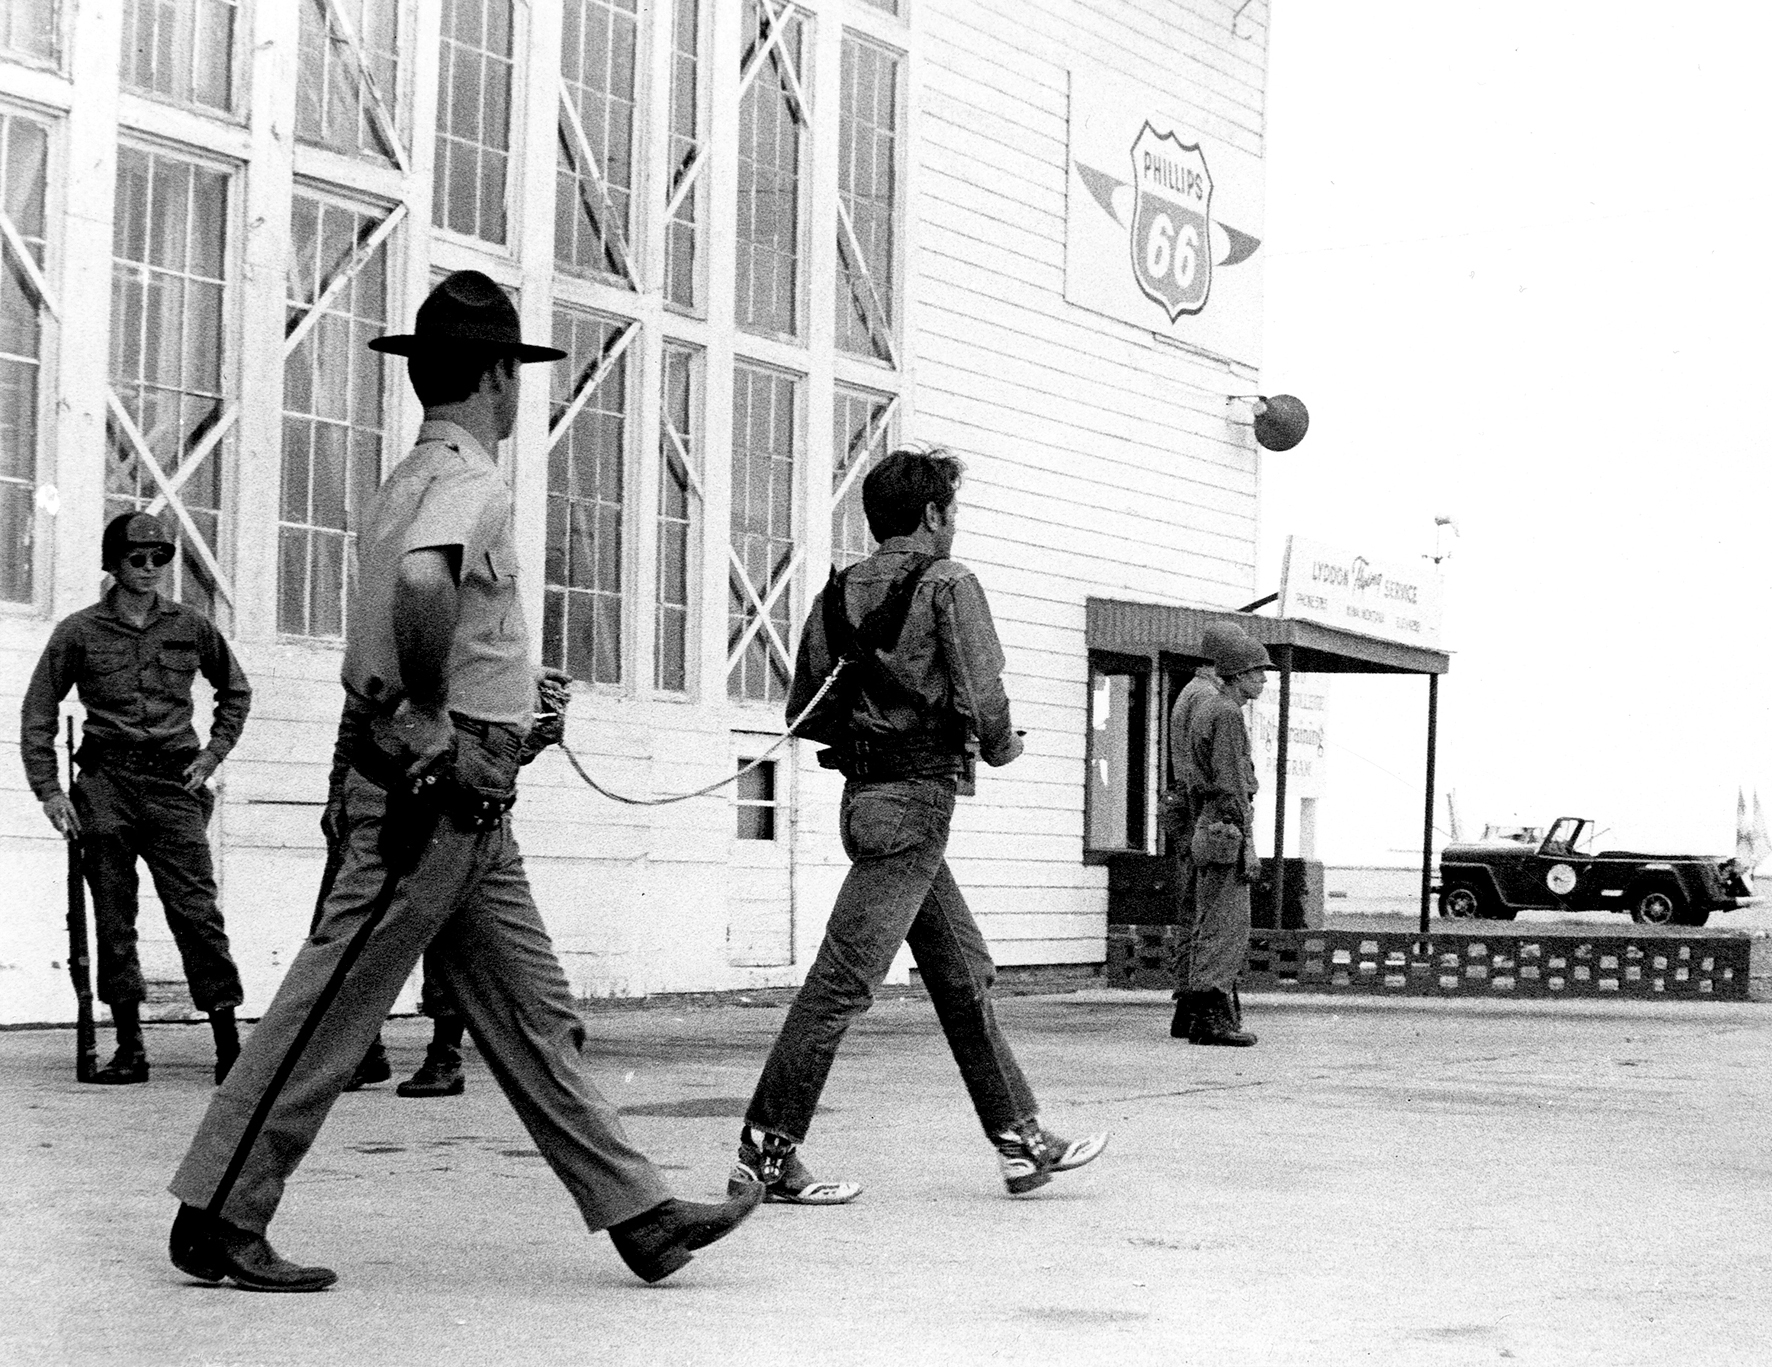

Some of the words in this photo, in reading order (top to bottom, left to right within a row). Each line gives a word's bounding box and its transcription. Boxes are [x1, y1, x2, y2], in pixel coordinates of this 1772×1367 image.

[1144, 150, 1203, 200] PHILLIPS
[1146, 212, 1199, 288] 66
[1384, 579, 1418, 605] SERVICE
